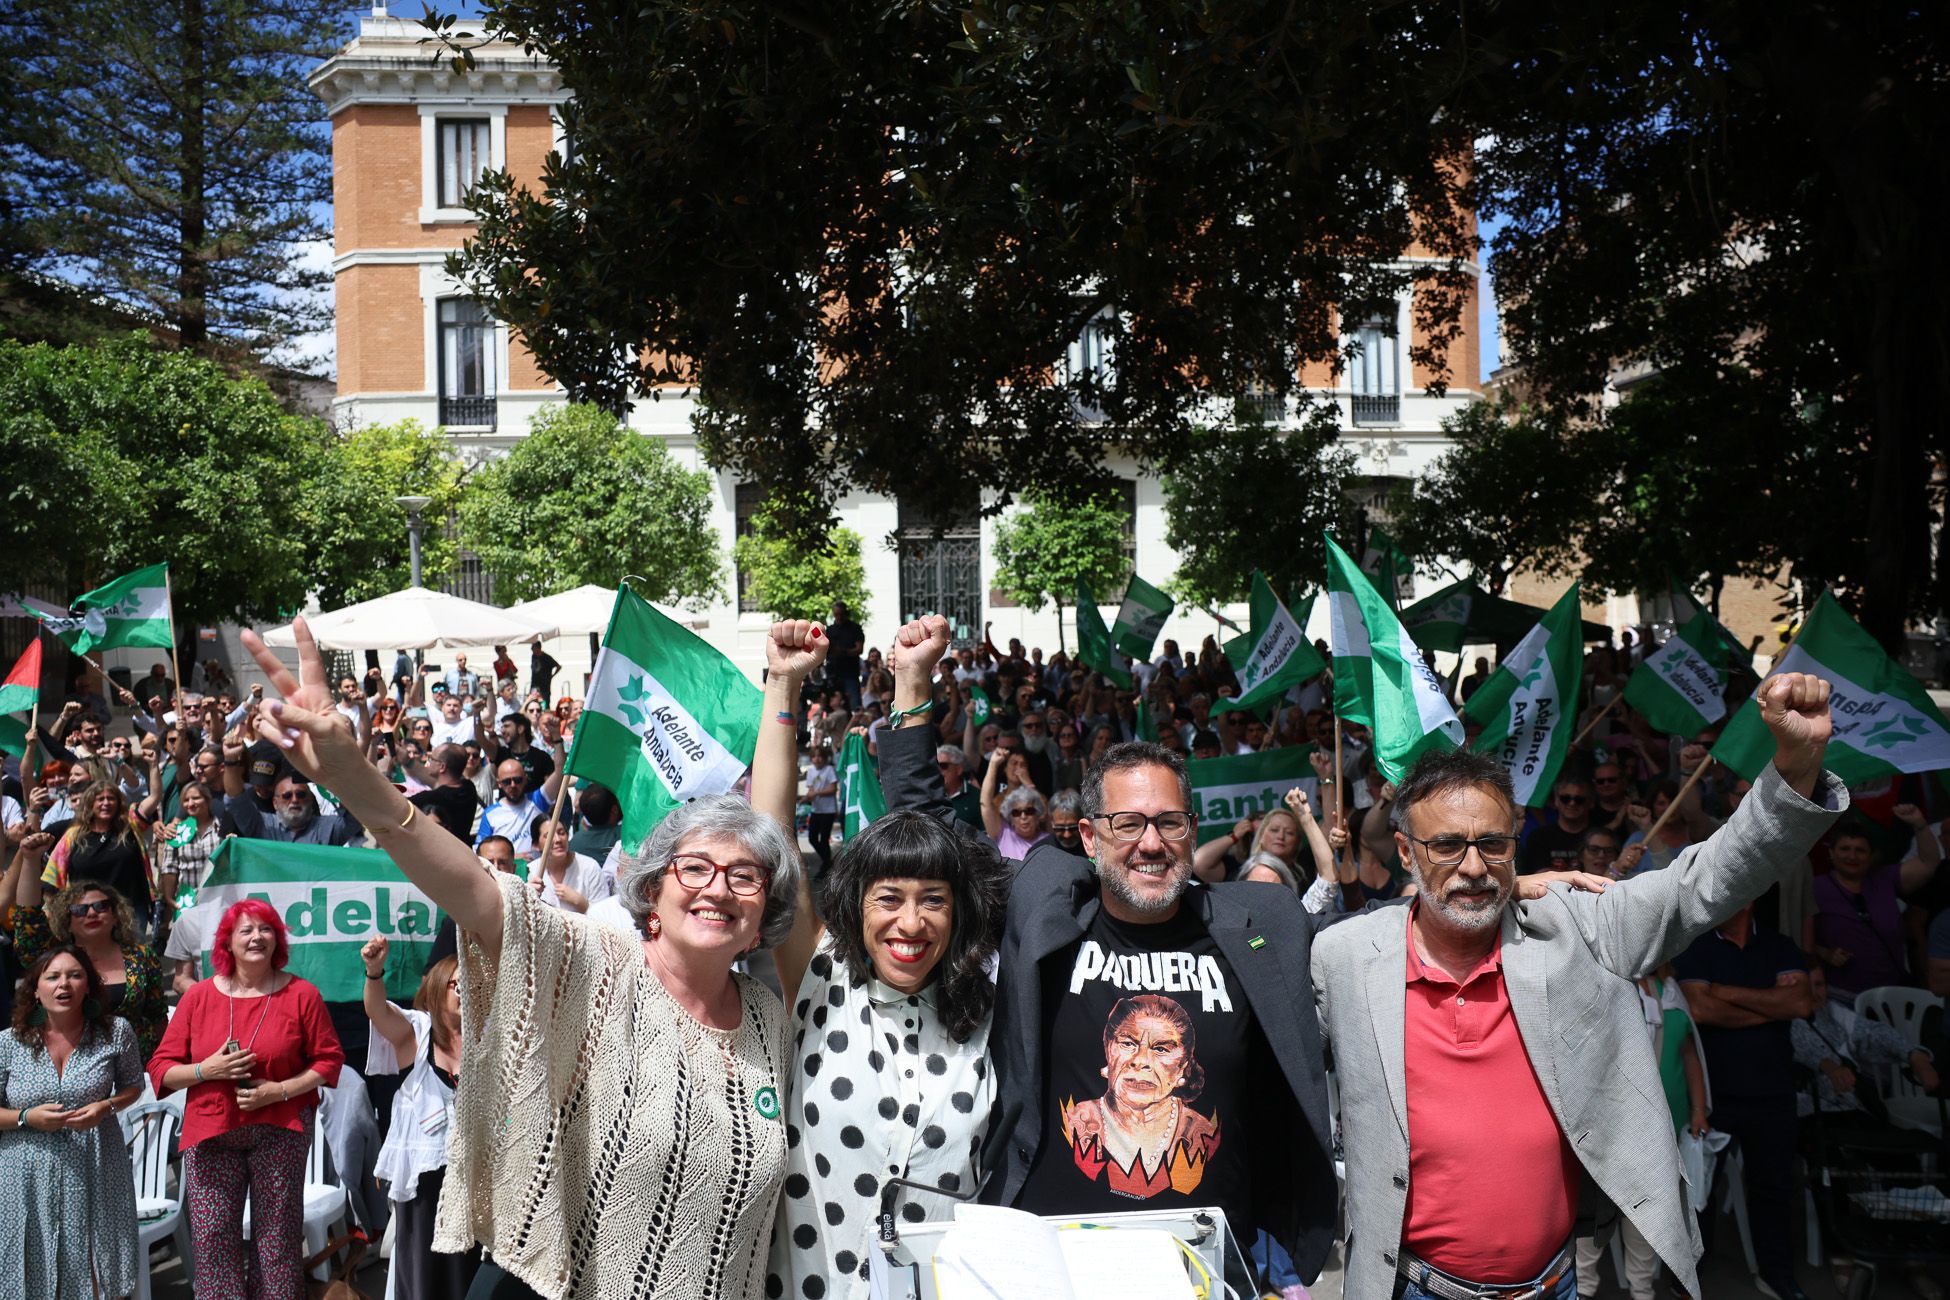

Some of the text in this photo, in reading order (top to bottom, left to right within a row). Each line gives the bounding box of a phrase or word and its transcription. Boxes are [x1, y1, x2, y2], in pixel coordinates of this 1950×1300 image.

[1258, 622, 1284, 660] Adelante
[651, 706, 705, 762] Adelante
[1522, 698, 1553, 776] Adelante
[1070, 940, 1233, 1012] PAQUERA
[883, 1213, 893, 1240] eleka
